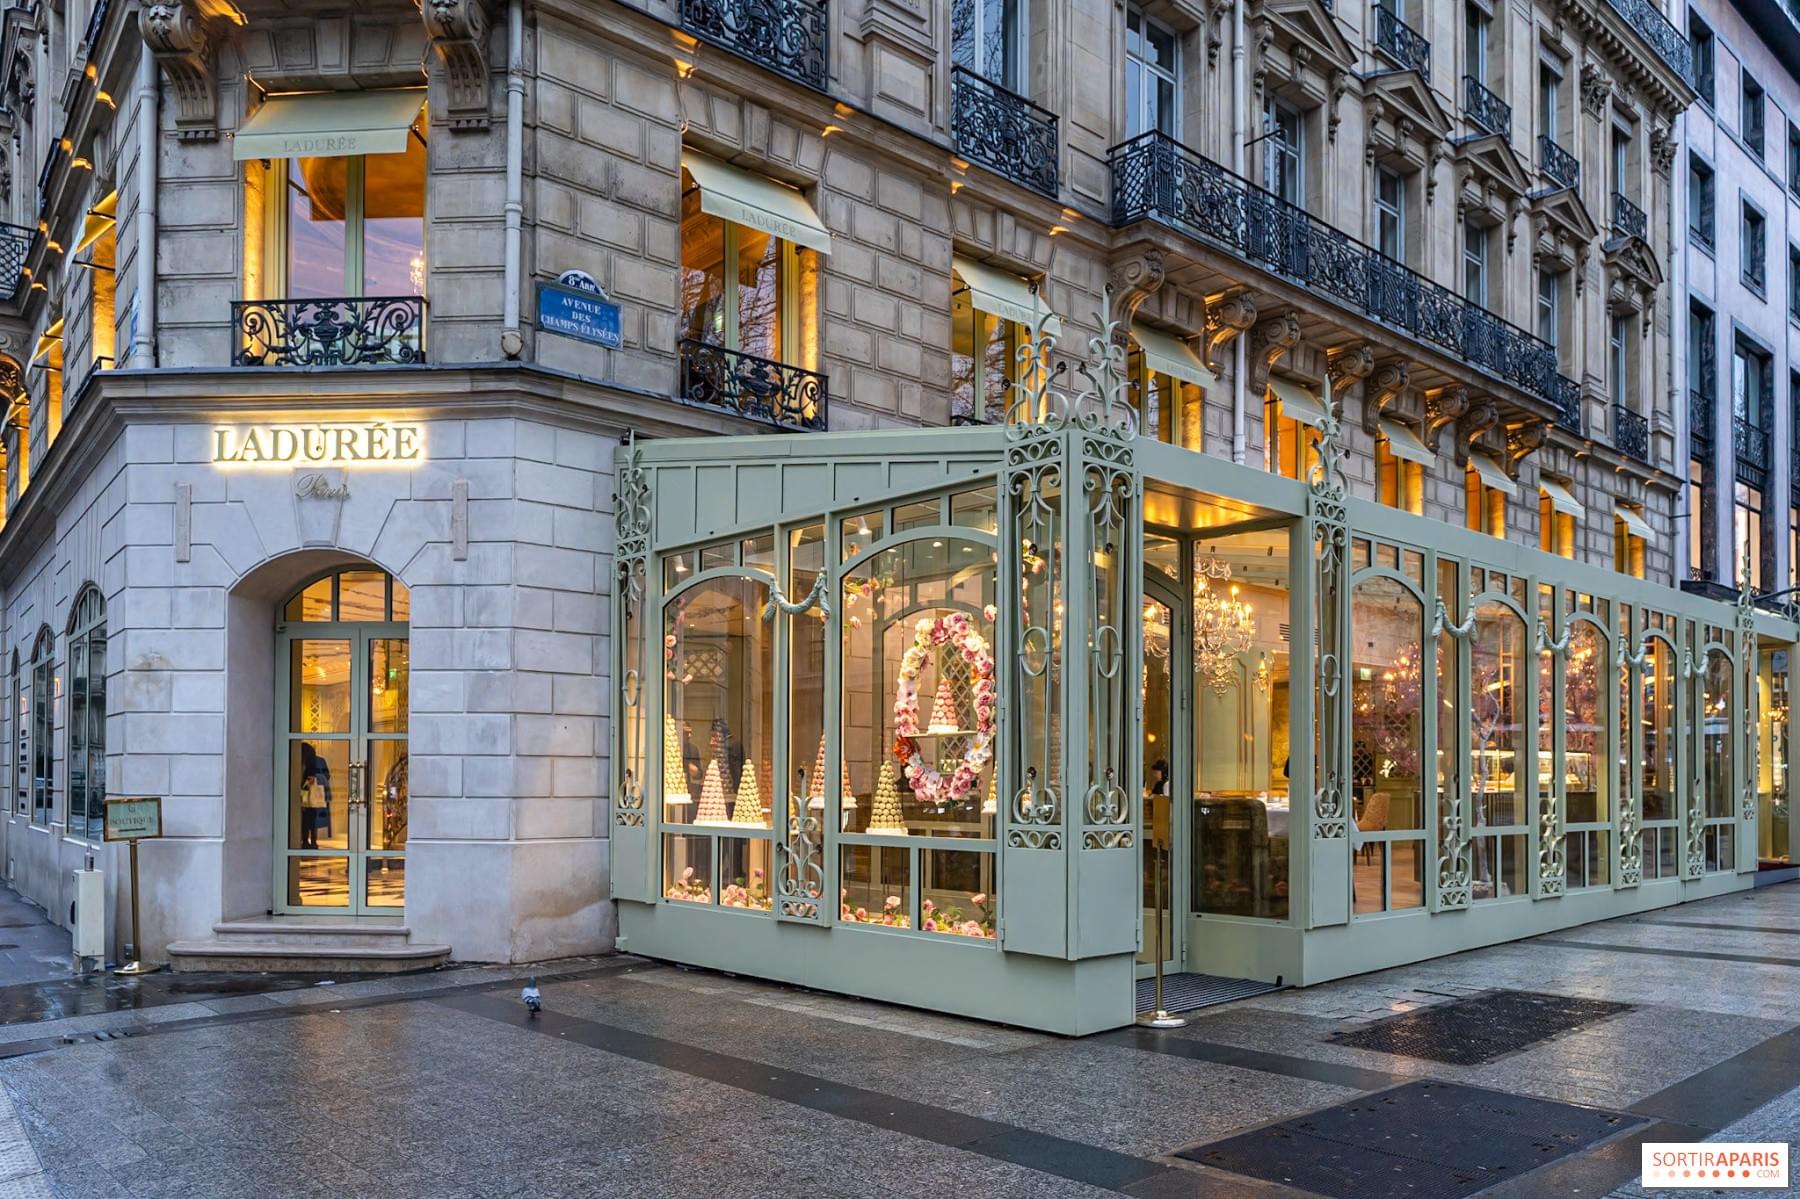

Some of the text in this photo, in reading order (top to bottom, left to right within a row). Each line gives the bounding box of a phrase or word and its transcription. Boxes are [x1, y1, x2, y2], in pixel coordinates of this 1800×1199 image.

[283, 136, 356, 153] LADURÉE
[561, 297, 601, 315] AVENUE
[572, 312, 592, 323] DES
[541, 314, 619, 342] CHAMPS ÉLYSÉES
[213, 422, 420, 462] LADURÉE
